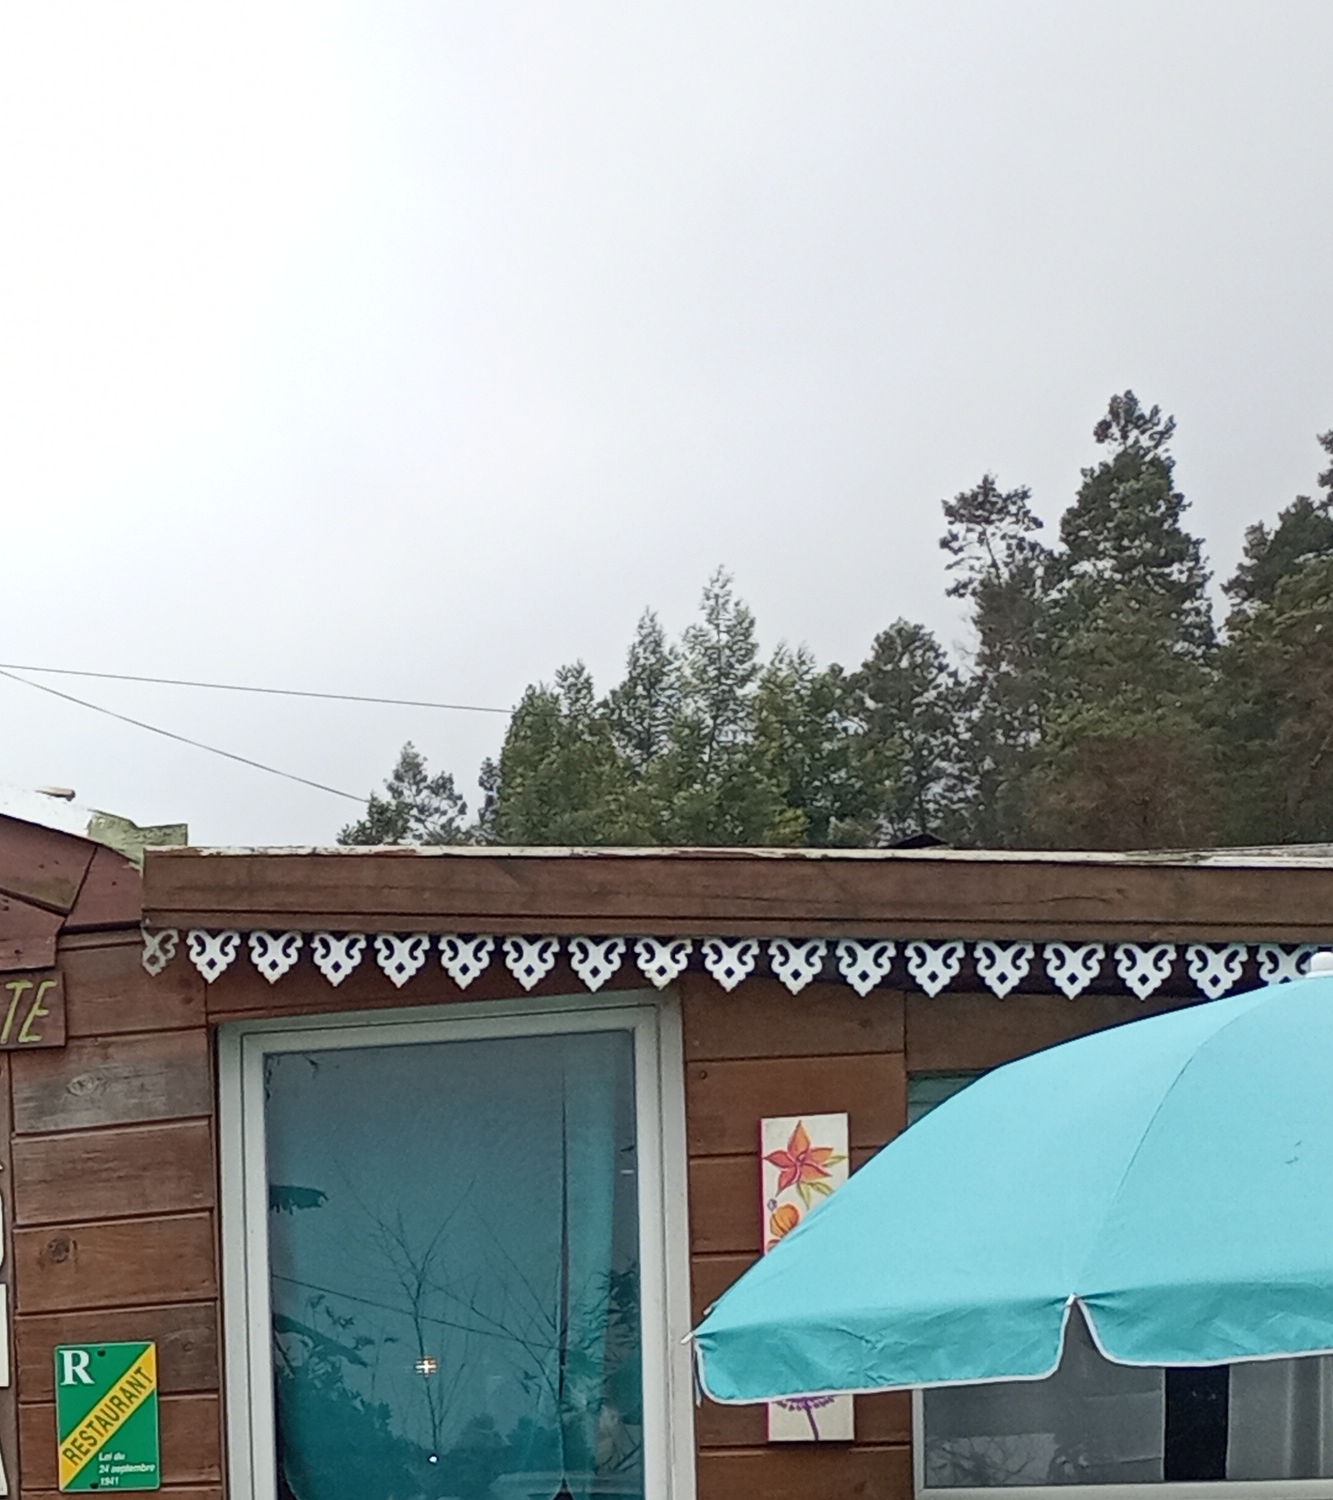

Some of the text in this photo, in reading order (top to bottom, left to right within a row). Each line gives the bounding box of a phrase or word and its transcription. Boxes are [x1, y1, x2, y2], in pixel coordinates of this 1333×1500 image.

[59, 1350, 95, 1386] R
[62, 1366, 153, 1467] RESTAURANT
[98, 1463, 156, 1475] 24 septembre
